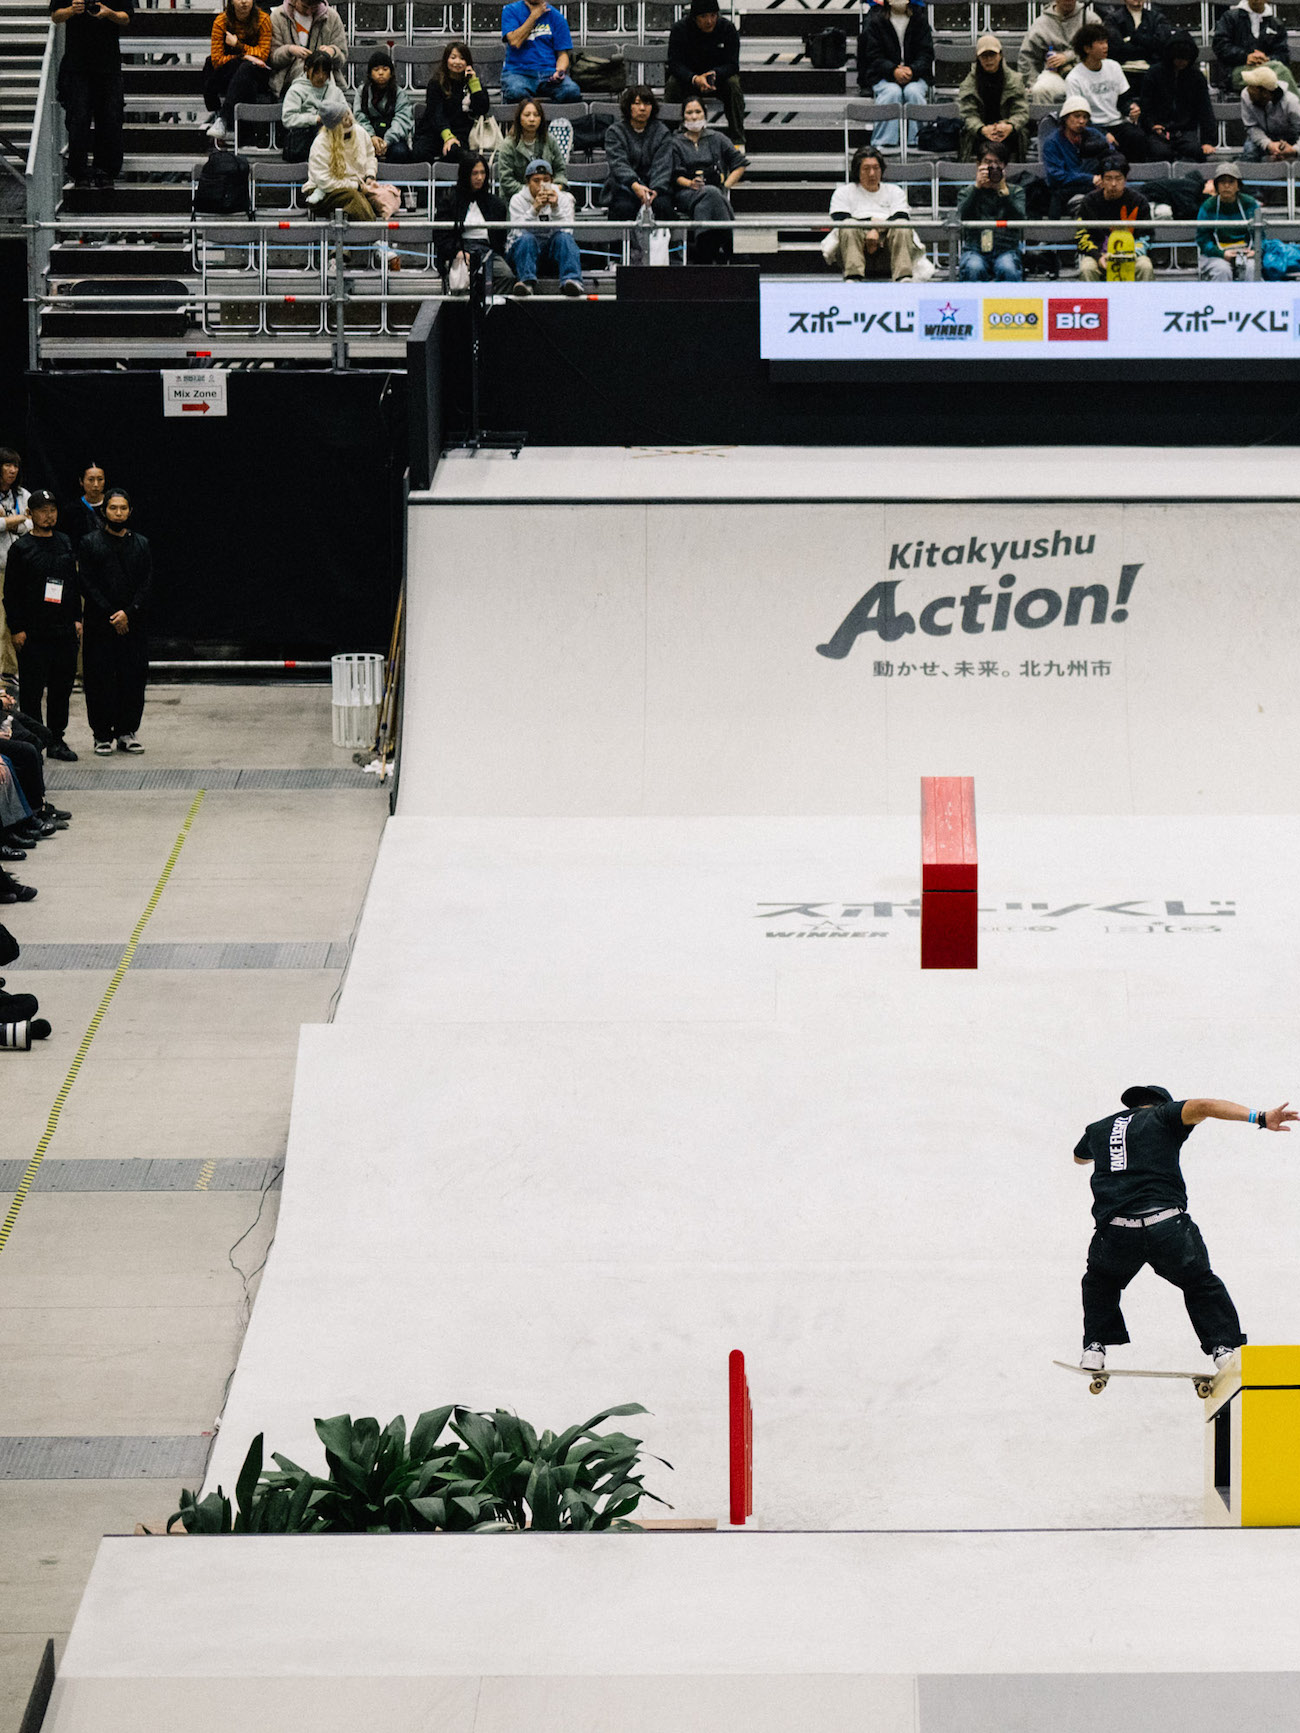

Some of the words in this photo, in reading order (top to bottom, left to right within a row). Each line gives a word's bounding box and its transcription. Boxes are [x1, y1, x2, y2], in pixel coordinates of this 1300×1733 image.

[788, 306, 914, 333] スポーツくじ
[924, 324, 973, 337] WINNER
[1163, 305, 1289, 332] スポーツくじ
[174, 389, 190, 398] Mix
[193, 389, 217, 398] Zone
[888, 530, 1096, 570] Kitakyushu
[815, 563, 1145, 660] Action!
[1109, 1146, 1125, 1172] TAKE
